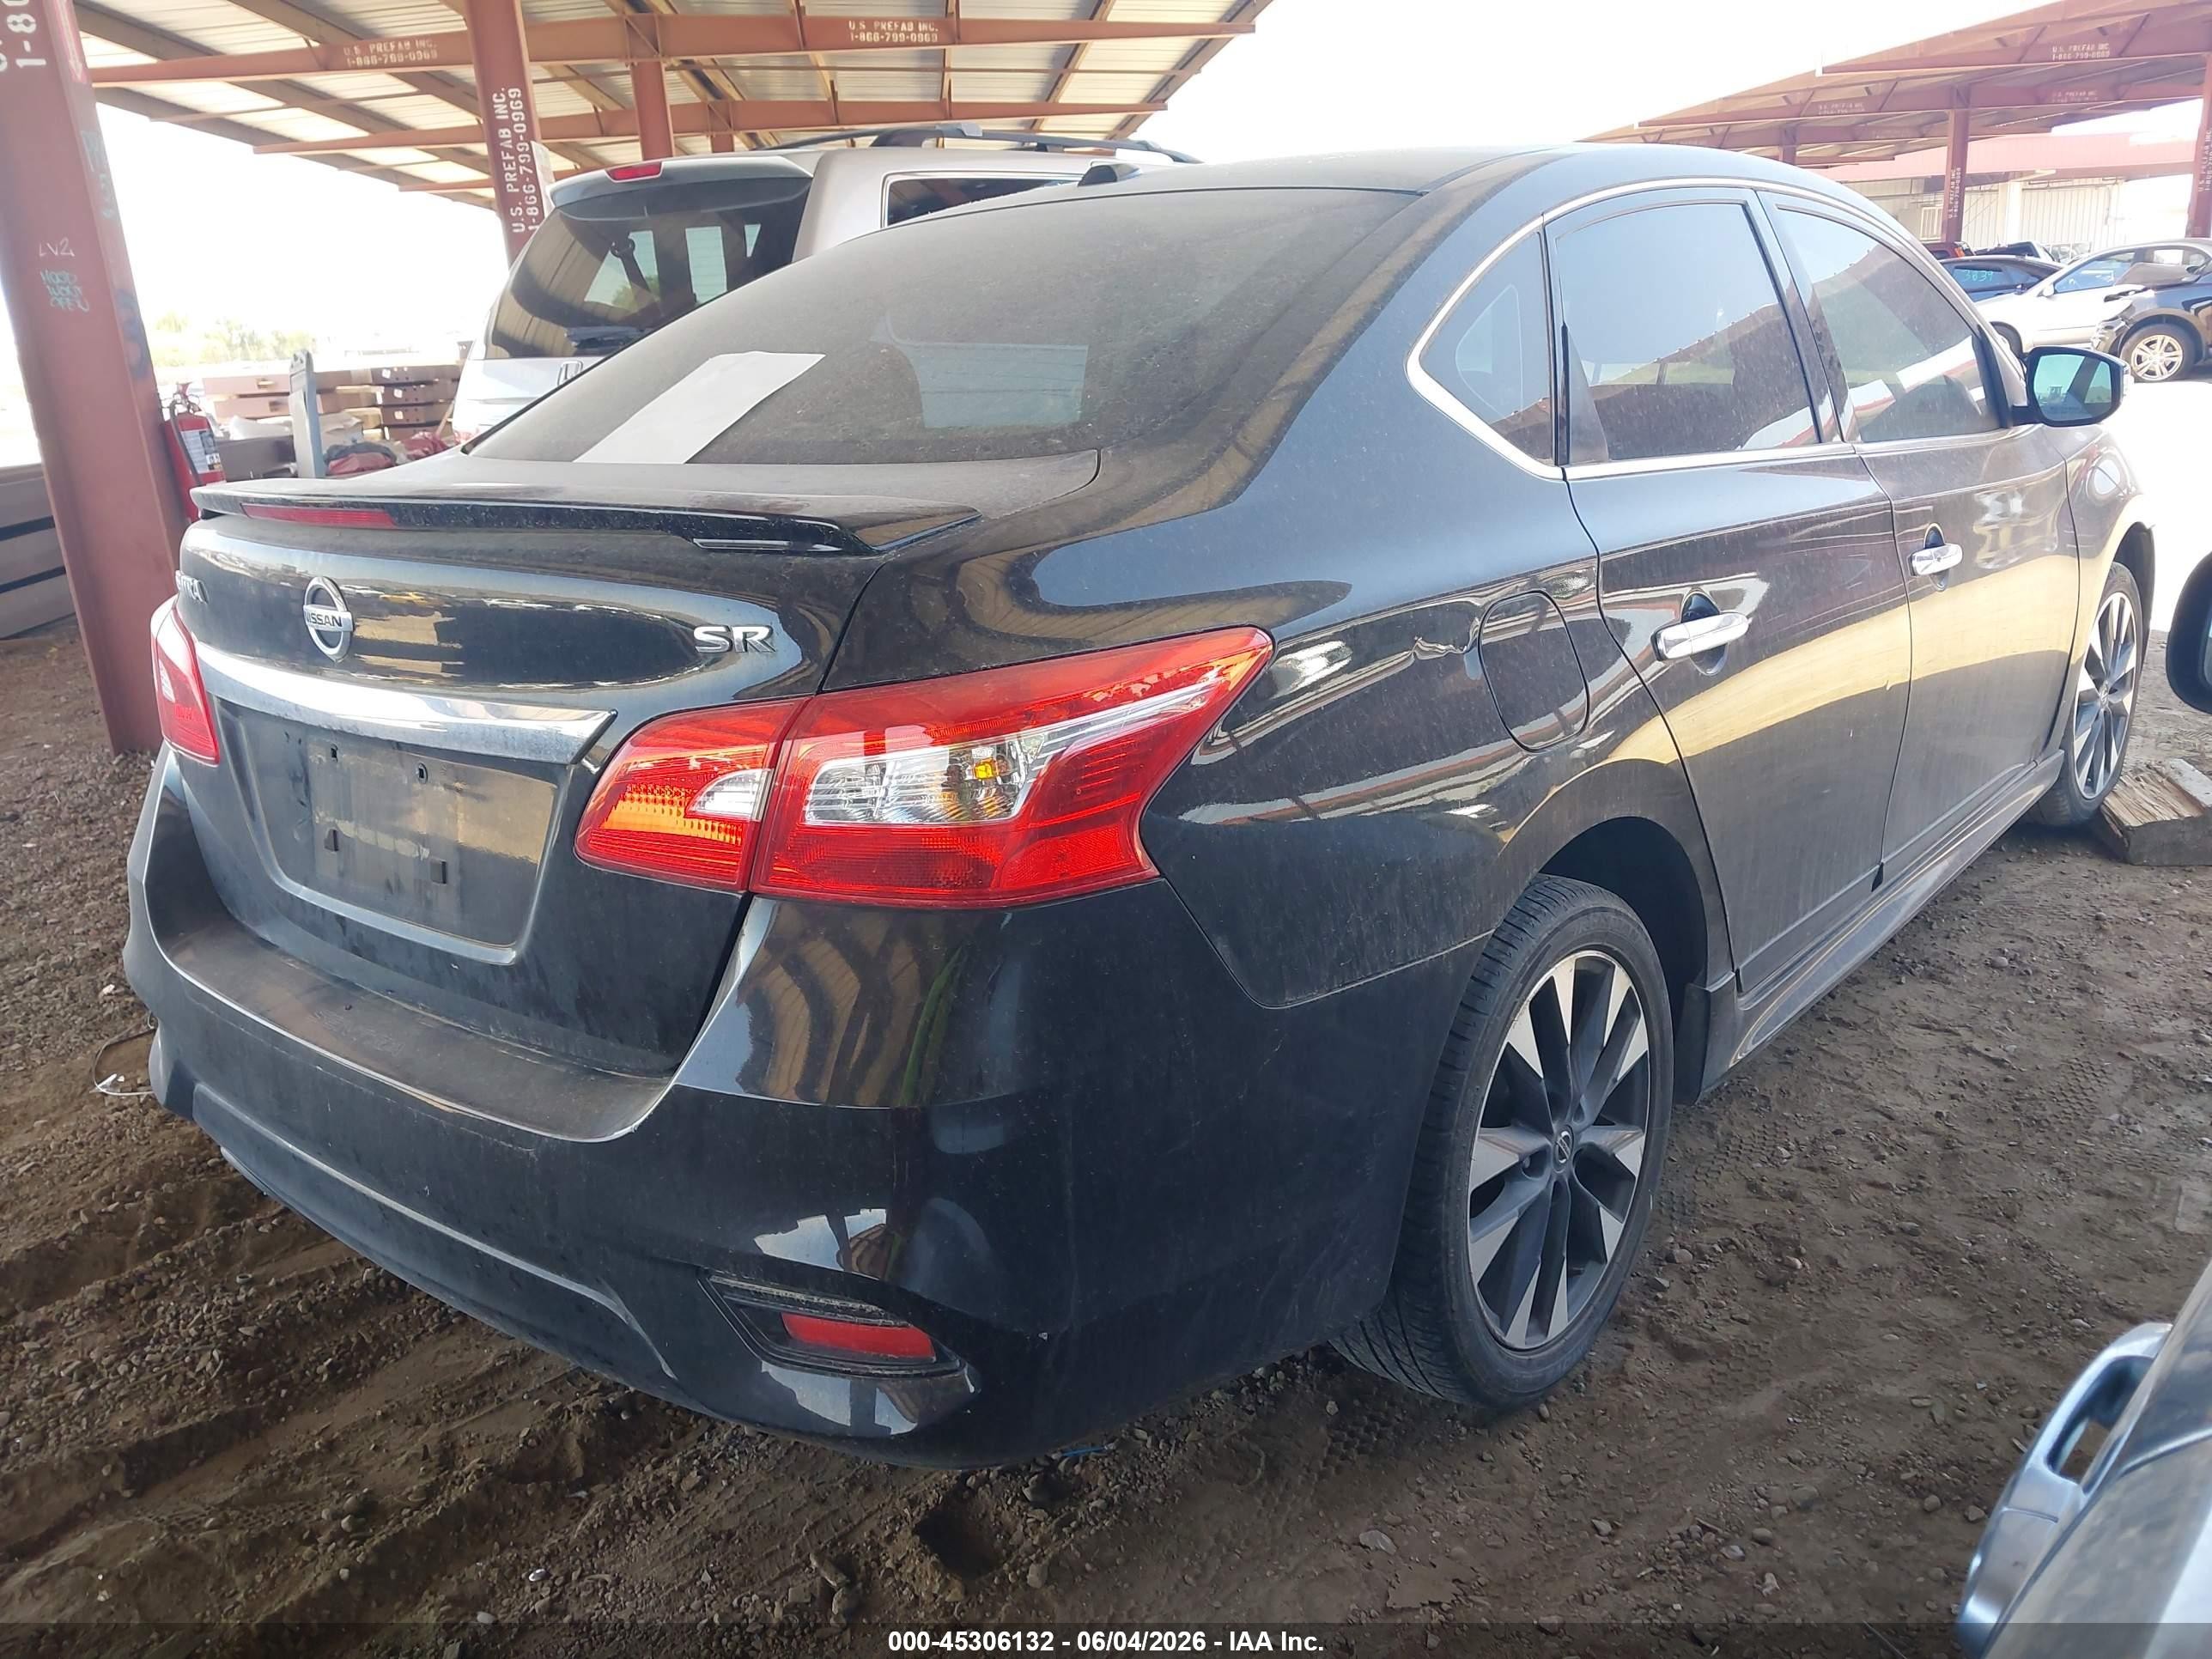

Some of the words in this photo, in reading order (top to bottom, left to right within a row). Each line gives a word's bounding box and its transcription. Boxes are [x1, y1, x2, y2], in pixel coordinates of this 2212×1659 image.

[873, 21, 915, 32] PREFAB
[492, 87, 509, 119] INC.
[498, 127, 520, 193] PREFAB
[507, 88, 540, 232] 1-866-799-0969
[510, 202, 526, 233] U.S.
[306, 610, 343, 628] NISSAN
[693, 625, 776, 653] SR
